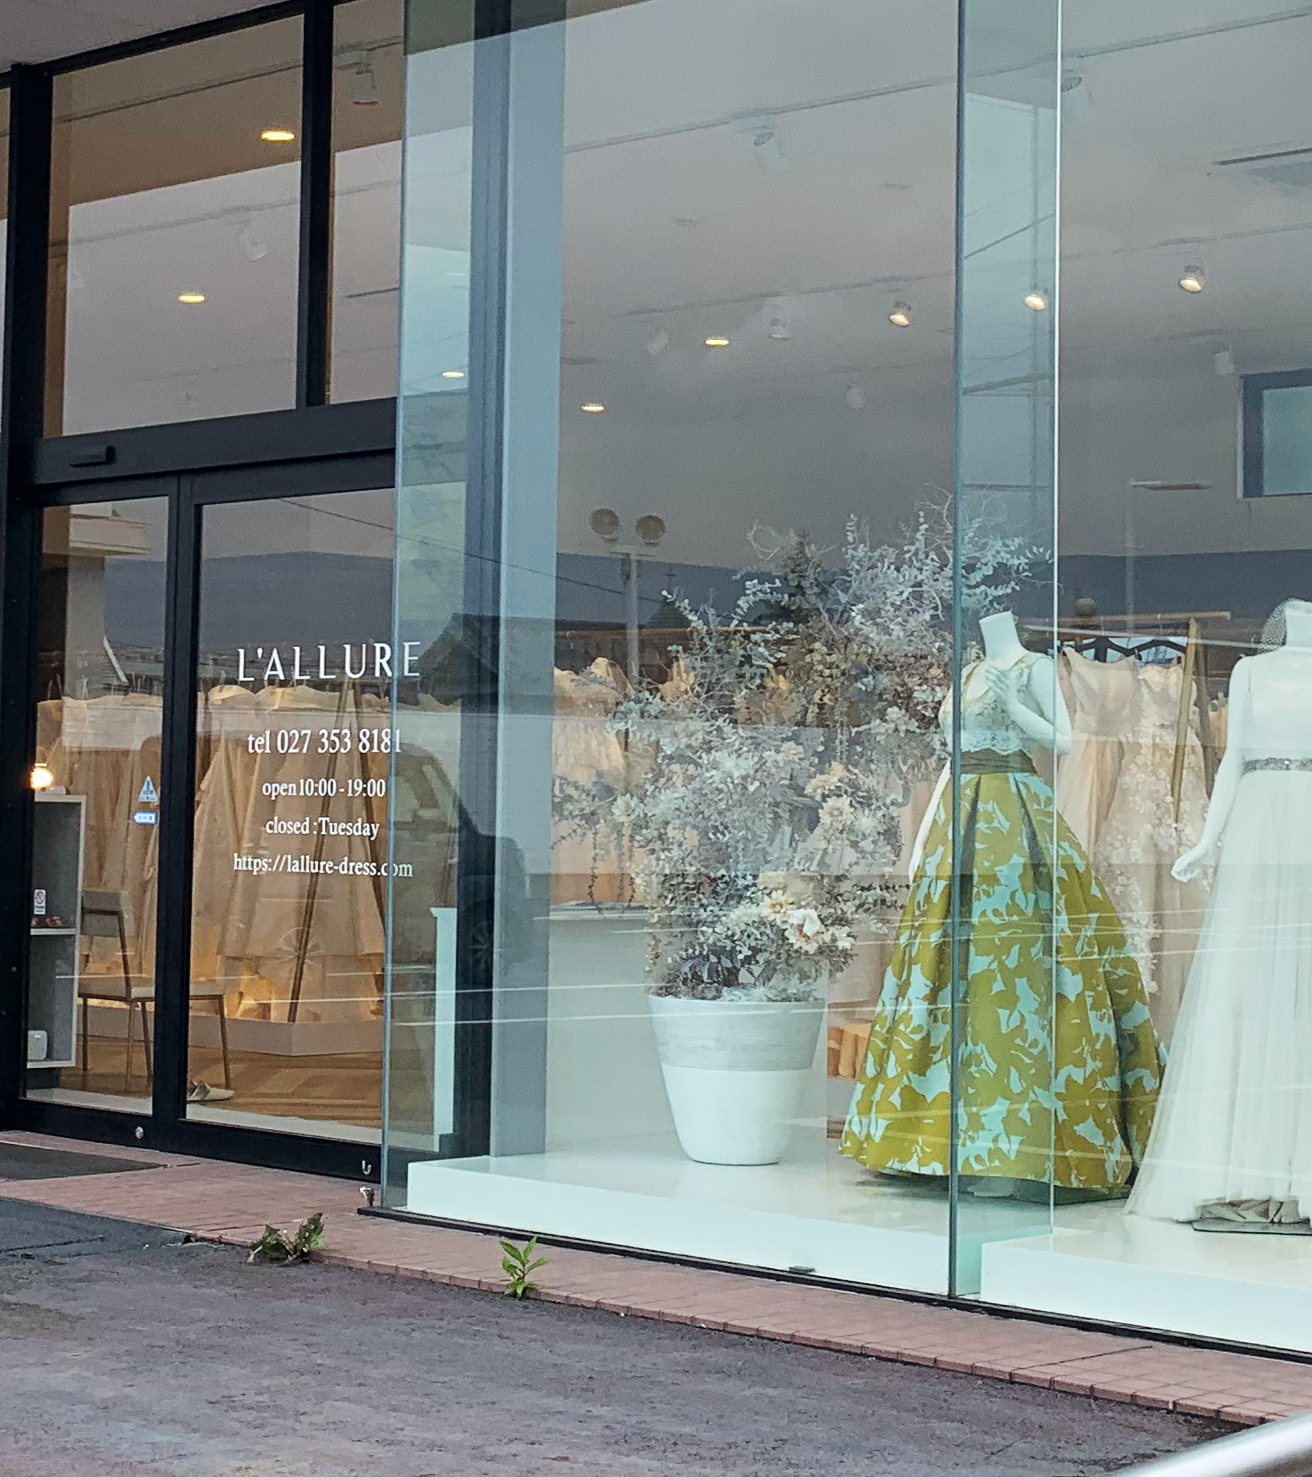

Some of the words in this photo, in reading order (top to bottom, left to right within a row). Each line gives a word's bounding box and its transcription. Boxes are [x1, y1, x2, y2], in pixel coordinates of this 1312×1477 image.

[237, 641, 421, 681] L'ALLURE
[247, 730, 271, 754] tel
[277, 729, 311, 754] 027
[317, 729, 351, 754] 353
[358, 728, 401, 753] 8181
[347, 780, 386, 797] 19:00
[265, 816, 310, 835] closed
[233, 853, 413, 877] https://lallure-dress.com
